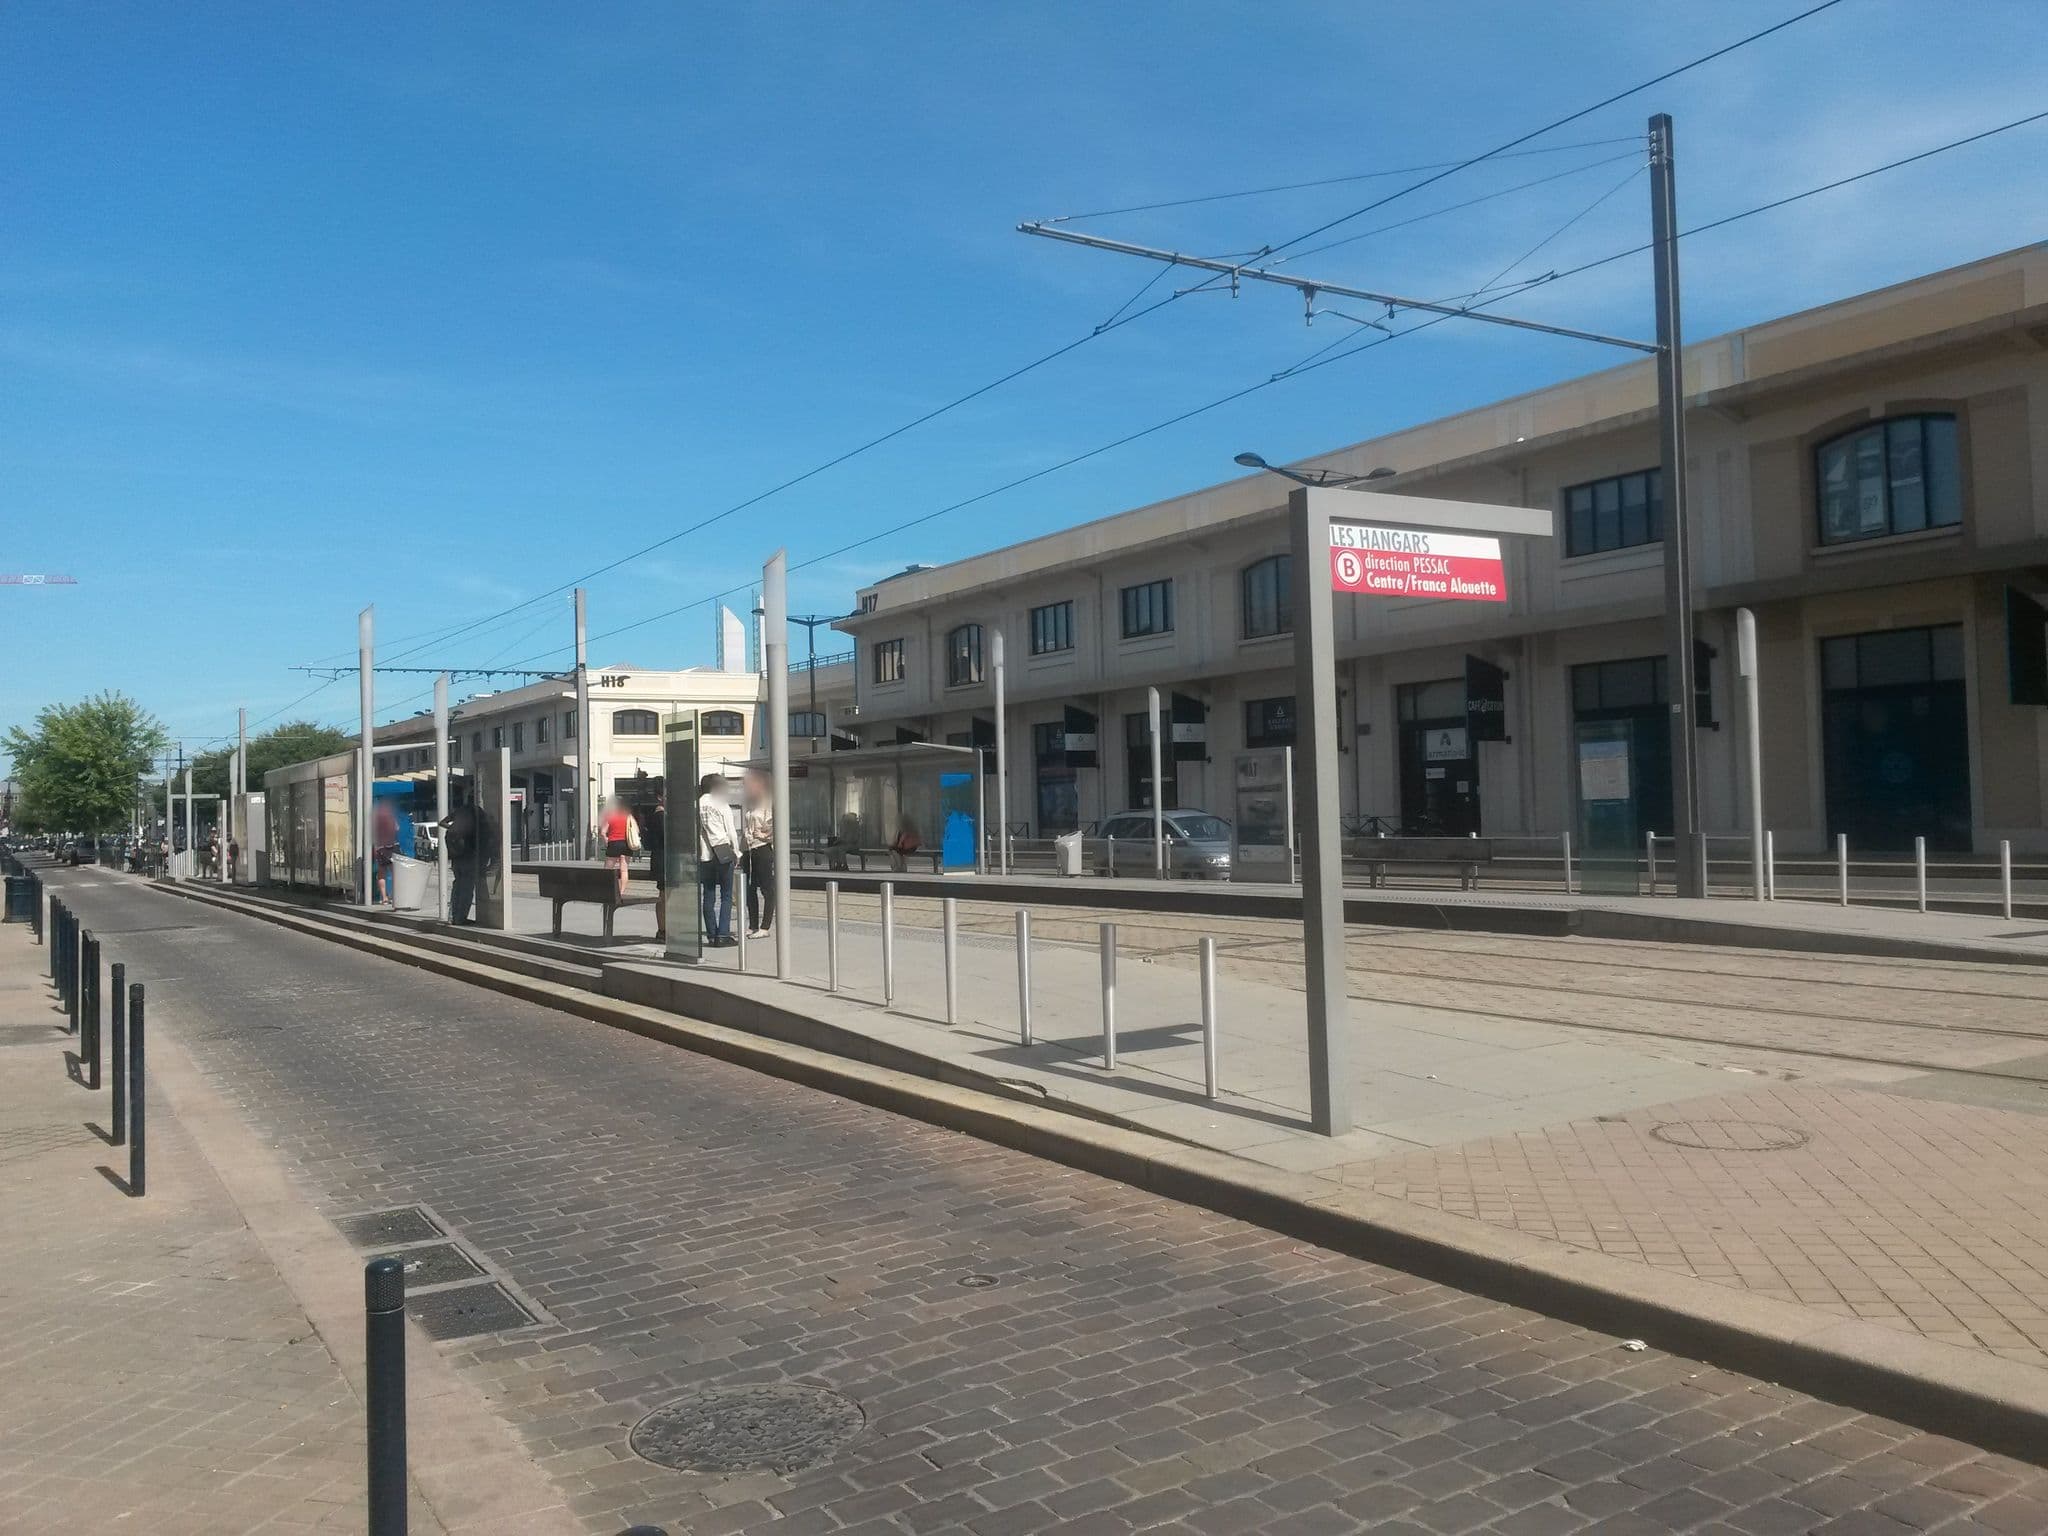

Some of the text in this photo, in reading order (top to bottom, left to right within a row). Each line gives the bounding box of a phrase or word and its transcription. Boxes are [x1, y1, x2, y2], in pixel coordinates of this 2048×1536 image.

[1331, 526, 1430, 554] LES HANGARS
[1343, 557, 1355, 577] B
[1365, 551, 1450, 575] direction PESSAC
[1366, 571, 1497, 595] Centre/France Alouette
